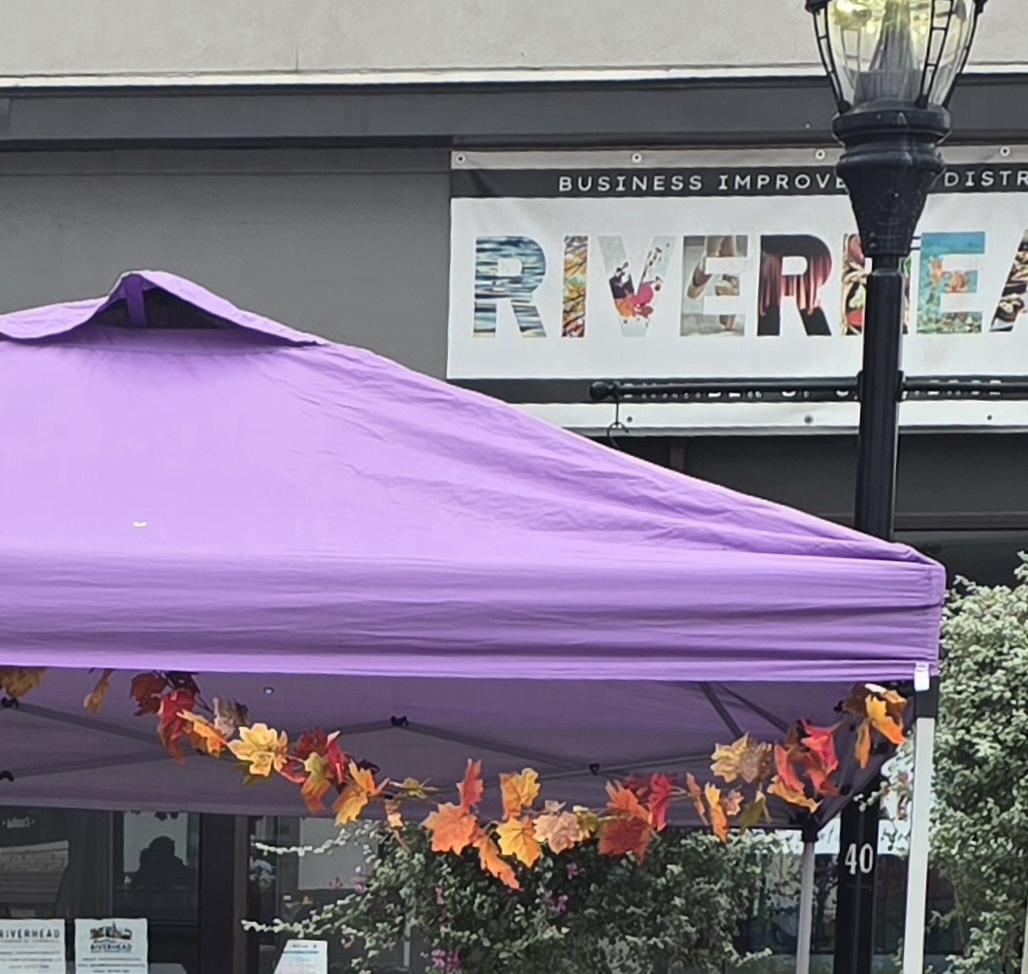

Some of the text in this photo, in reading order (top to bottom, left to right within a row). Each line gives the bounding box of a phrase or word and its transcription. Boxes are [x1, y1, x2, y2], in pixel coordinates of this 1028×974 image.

[558, 174, 703, 193] BUSINESS
[719, 172, 845, 190] IMPROV
[844, 843, 873, 875] 40
